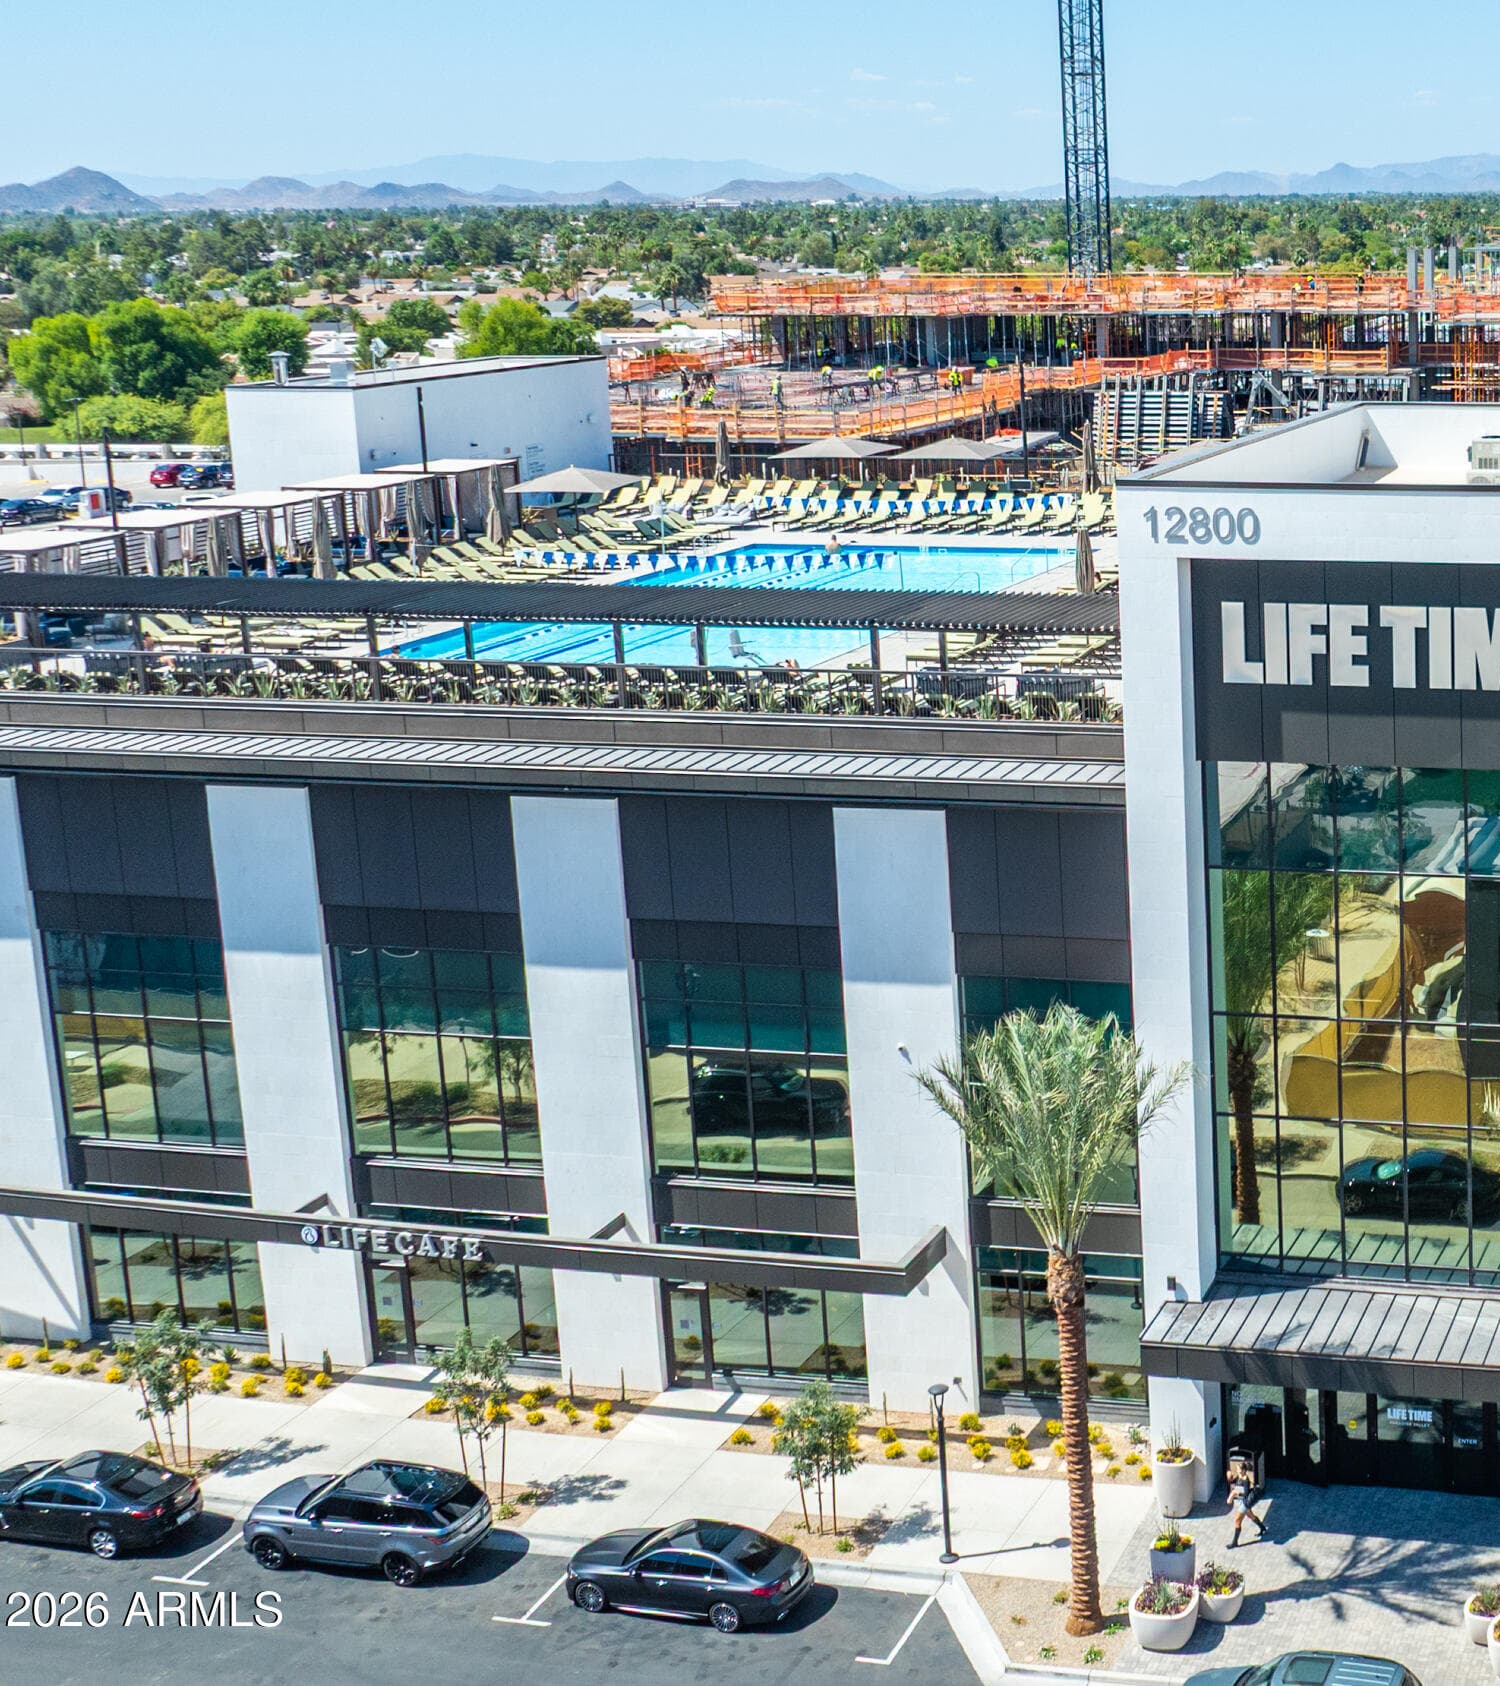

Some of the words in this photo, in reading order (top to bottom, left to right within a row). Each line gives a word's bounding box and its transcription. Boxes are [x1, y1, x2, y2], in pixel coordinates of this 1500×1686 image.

[1143, 505, 1261, 545] 12800
[1221, 601, 1370, 688] LIFE
[1387, 1408, 1407, 1420] LIFE
[1408, 1410, 1433, 1422] TIME
